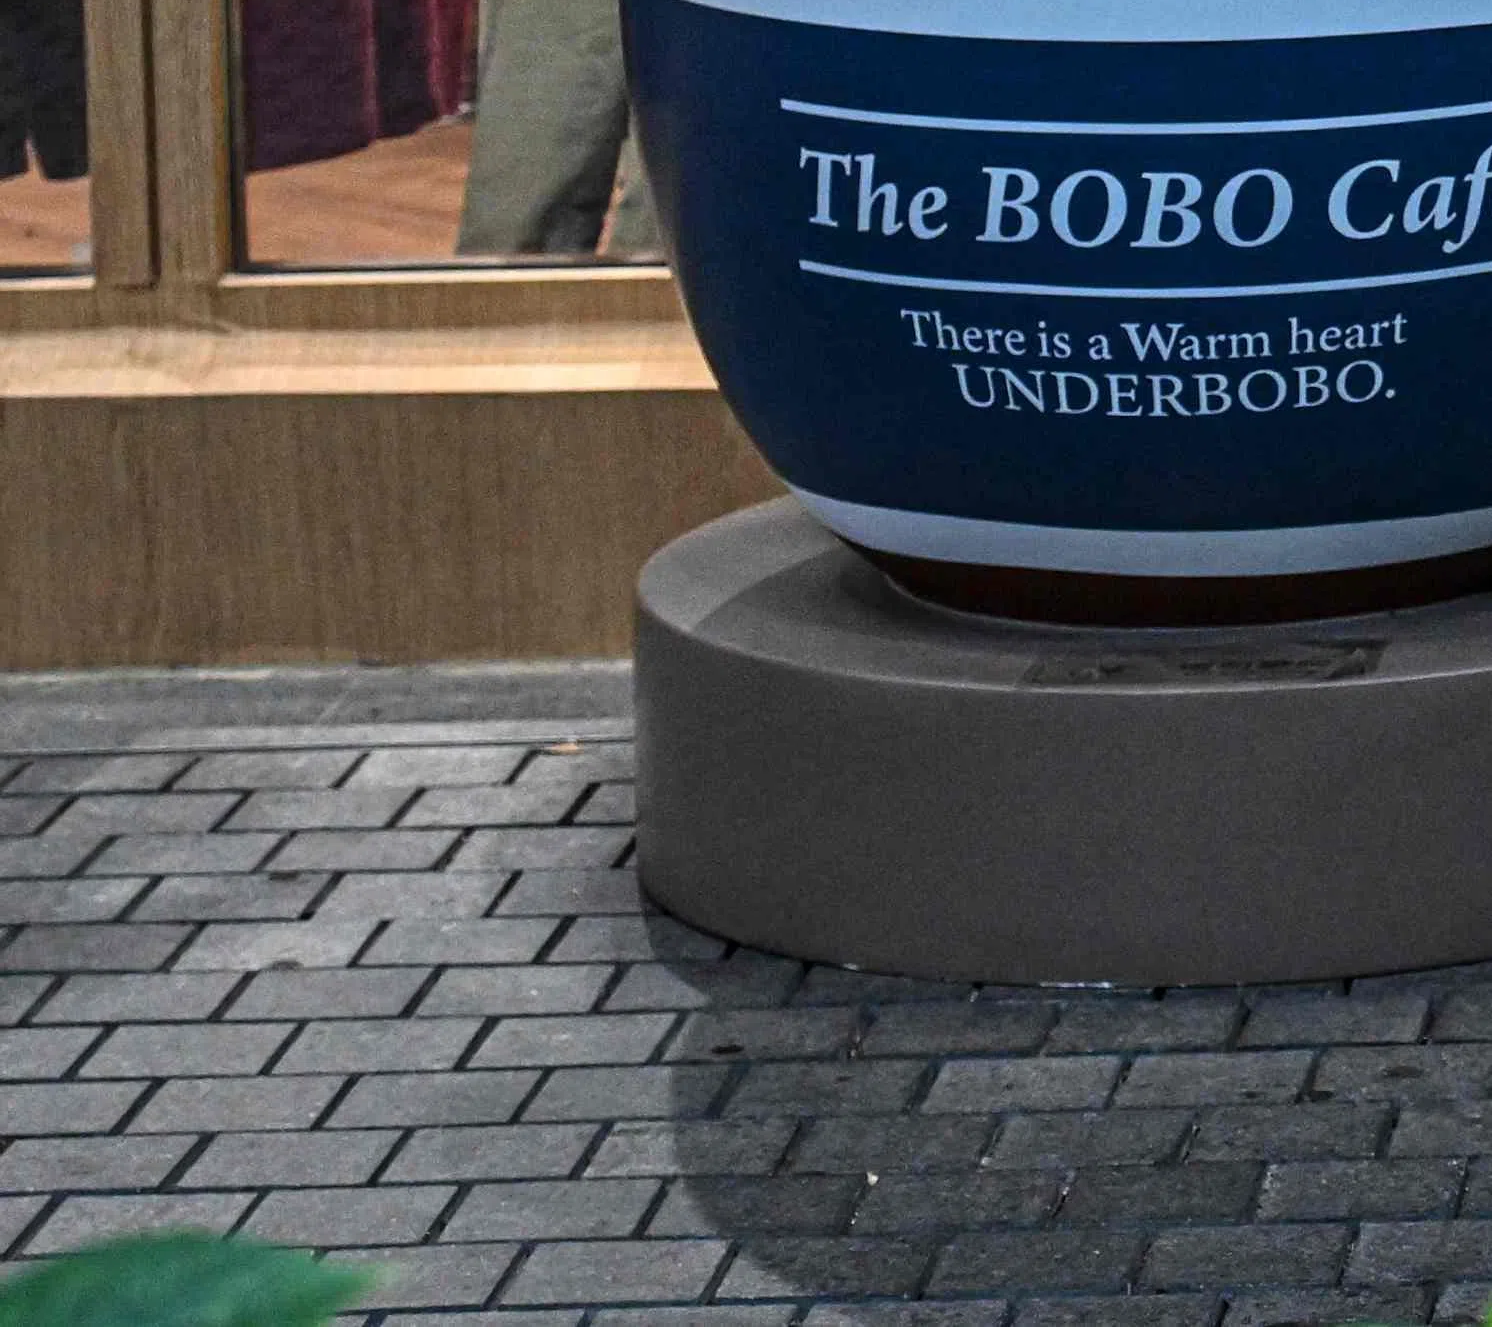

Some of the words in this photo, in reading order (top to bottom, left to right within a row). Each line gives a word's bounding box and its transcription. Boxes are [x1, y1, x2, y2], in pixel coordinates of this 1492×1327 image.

[799, 146, 948, 240] The
[975, 166, 1294, 248] BOBO
[901, 309, 1026, 357] There
[1037, 321, 1072, 359] is
[1088, 334, 1113, 361] a
[1119, 322, 1272, 362] Warm
[1288, 310, 1408, 360] heart
[951, 359, 1396, 417] UNDERBOBO.
